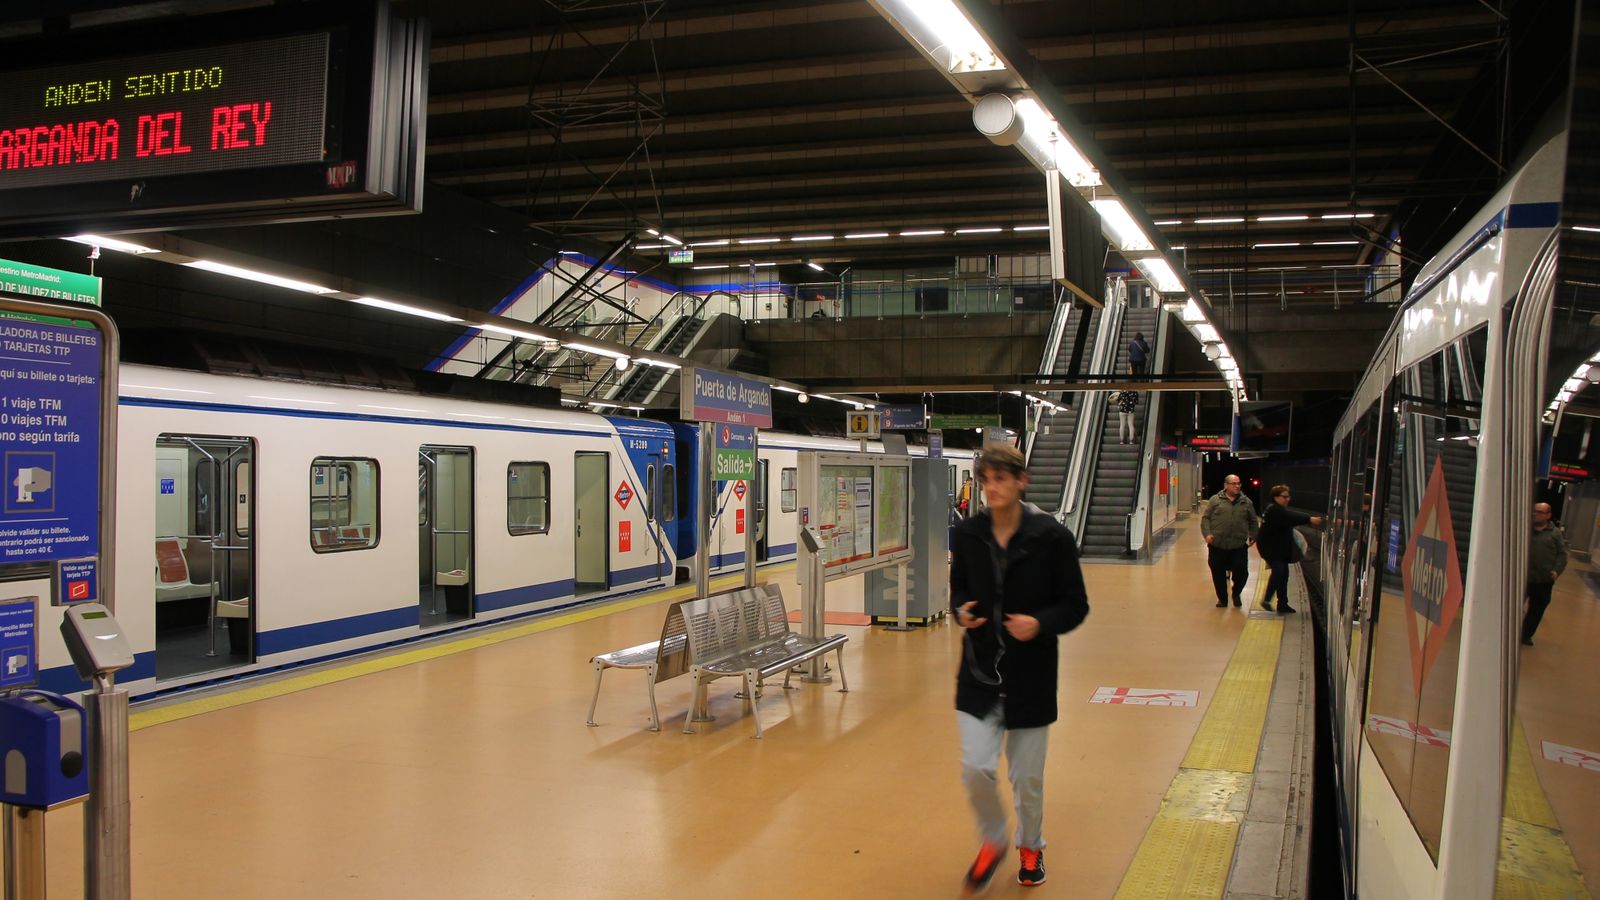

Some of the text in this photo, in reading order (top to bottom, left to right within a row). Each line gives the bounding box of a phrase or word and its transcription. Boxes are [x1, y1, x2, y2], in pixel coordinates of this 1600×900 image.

[45, 66, 224, 108] ANDEN SENTIDO
[0, 102, 272, 170] ARGANDA DEL REY
[5, 282, 16, 293] DE
[50, 289, 61, 299] DE
[40, 330, 54, 341] DE
[56, 332, 97, 346] BILLETES
[4, 340, 70, 356] TARJETAS TTP
[17, 371, 28, 379] su
[30, 370, 57, 381] billete
[59, 374, 65, 382] o
[66, 373, 96, 385] tarjeta:
[695, 374, 769, 408] Puerta de Arganda
[2, 396, 62, 412] 1 viaje TFM
[1, 413, 67, 428] 0 viajes TFM
[19, 430, 51, 444] según
[54, 431, 80, 443] tarifa
[717, 453, 745, 474] Salida
[19, 527, 40, 536] validar
[24, 536, 43, 547] podrá
[55, 535, 90, 543] sancionado
[6, 547, 24, 556] hasta
[25, 547, 37, 555] con
[37, 546, 46, 554] 40
[1413, 545, 1444, 606] Metro
